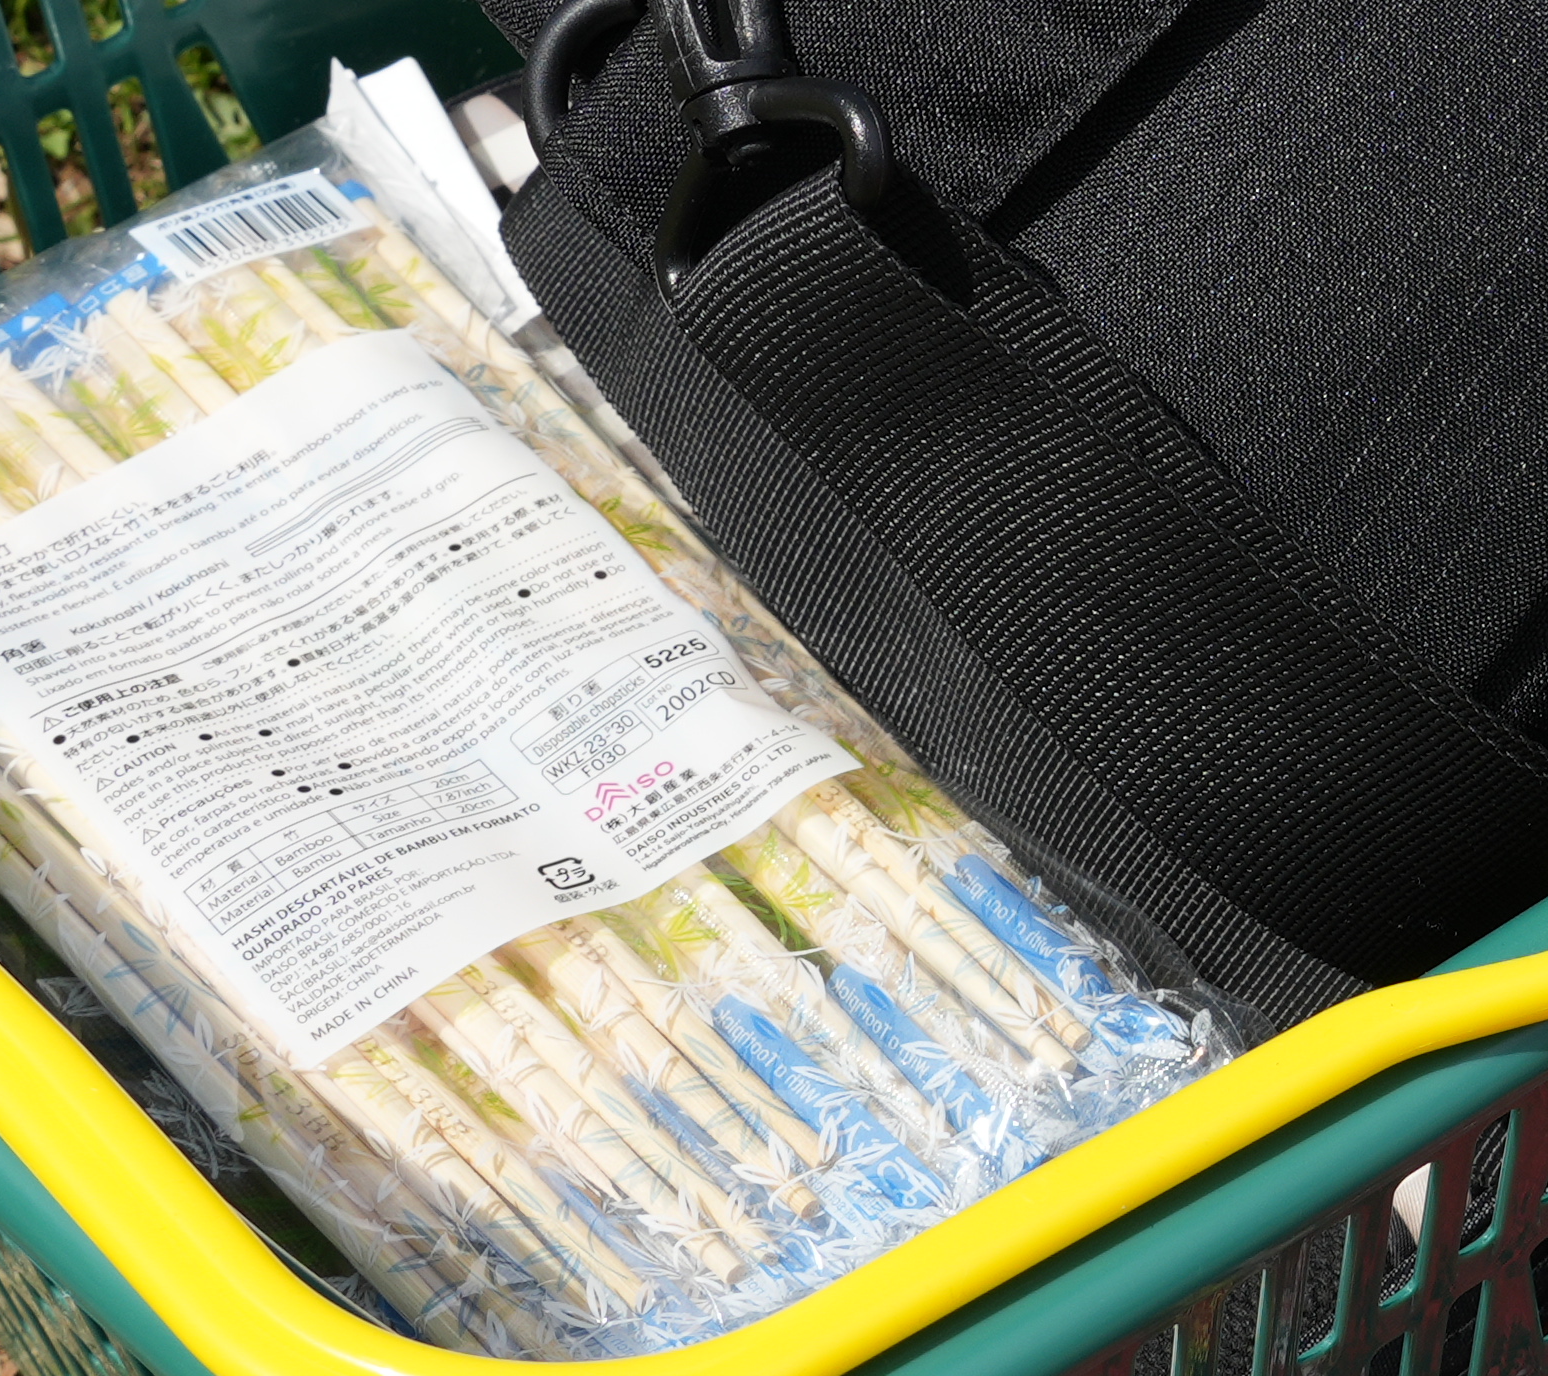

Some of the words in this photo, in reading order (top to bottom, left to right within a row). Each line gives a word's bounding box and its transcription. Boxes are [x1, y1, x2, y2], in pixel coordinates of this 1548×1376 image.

[7, 579, 62, 602] flexible,
[61, 564, 88, 581] and
[88, 536, 143, 569] resistant
[157, 501, 219, 531] breaking.
[216, 485, 243, 501] The
[244, 465, 281, 489] entire
[280, 432, 332, 468] bamboo
[332, 407, 367, 434] shoot
[378, 385, 409, 403] used
[29, 579, 90, 607] avoiding
[87, 559, 126, 583] waste.
[68, 602, 147, 636] Kakuhashi
[154, 559, 230, 601] Kakuhashi
[0, 638, 46, 663] 角箸
[229, 722, 255, 733] the
[254, 698, 310, 727] material
[321, 672, 369, 698] natural
[367, 650, 406, 678] wood
[406, 626, 440, 653] there
[439, 603, 465, 627] may
[482, 578, 519, 599] some
[518, 562, 550, 583] color
[550, 540, 606, 567] variation
[643, 637, 707, 668] 5225
[61, 672, 182, 718] ご使用上の注意
[531, 713, 591, 758] Disposable
[588, 674, 646, 718] chopsticks
[659, 671, 736, 722] 2002CD
[121, 806, 148, 826] not
[146, 791, 172, 810] use
[170, 777, 199, 794] this
[198, 757, 256, 783] product
[253, 751, 275, 762] for
[275, 731, 339, 758] purposes
[338, 715, 375, 735] other
[375, 701, 408, 720] than
[406, 691, 425, 705] its
[423, 647, 479, 694] intended
[477, 617, 539, 652] purposes.
[102, 774, 145, 805] nodes
[145, 751, 192, 778] and/or
[193, 734, 257, 756] splinters.
[113, 742, 177, 777] CAUTION
[434, 773, 470, 789] 20cm
[580, 743, 626, 778] F030
[157, 778, 253, 829] Precauções
[351, 793, 396, 813] サイズ
[433, 781, 492, 803] 7.87inch
[455, 798, 495, 814] 20cm
[583, 758, 674, 822] DAISO
[624, 827, 667, 858] DAISO
[665, 780, 742, 831] INDUSTRIES
[740, 762, 769, 782] CO.,
[765, 743, 797, 762] LTD.
[364, 815, 432, 841] Tamanho
[371, 810, 401, 823] Size
[273, 834, 333, 867] Bamboo
[290, 849, 342, 878] Bambu
[554, 865, 586, 883] プラ
[206, 869, 262, 911] Material
[231, 915, 276, 950] HASHI
[274, 861, 375, 920] DESCARTÁVEL
[394, 831, 448, 856] BAMBU
[471, 802, 540, 831] FORMATO
[219, 884, 275, 925] Material
[241, 904, 322, 961] QUADRADO
[324, 889, 347, 906] -20
[346, 865, 393, 894] PARES
[250, 923, 322, 973] IMPORTADO
[320, 903, 354, 927] PARA
[352, 882, 395, 907] BRASIL
[392, 869, 424, 885] POR:
[259, 955, 298, 984] DAISO
[296, 930, 339, 960] BRASIL
[336, 891, 399, 932] COMÉRCIO
[406, 856, 486, 892] IMPORTAÇÃO
[484, 849, 520, 863] LTDA.
[309, 1008, 354, 1041] MADE
[372, 965, 418, 999] CHINA
